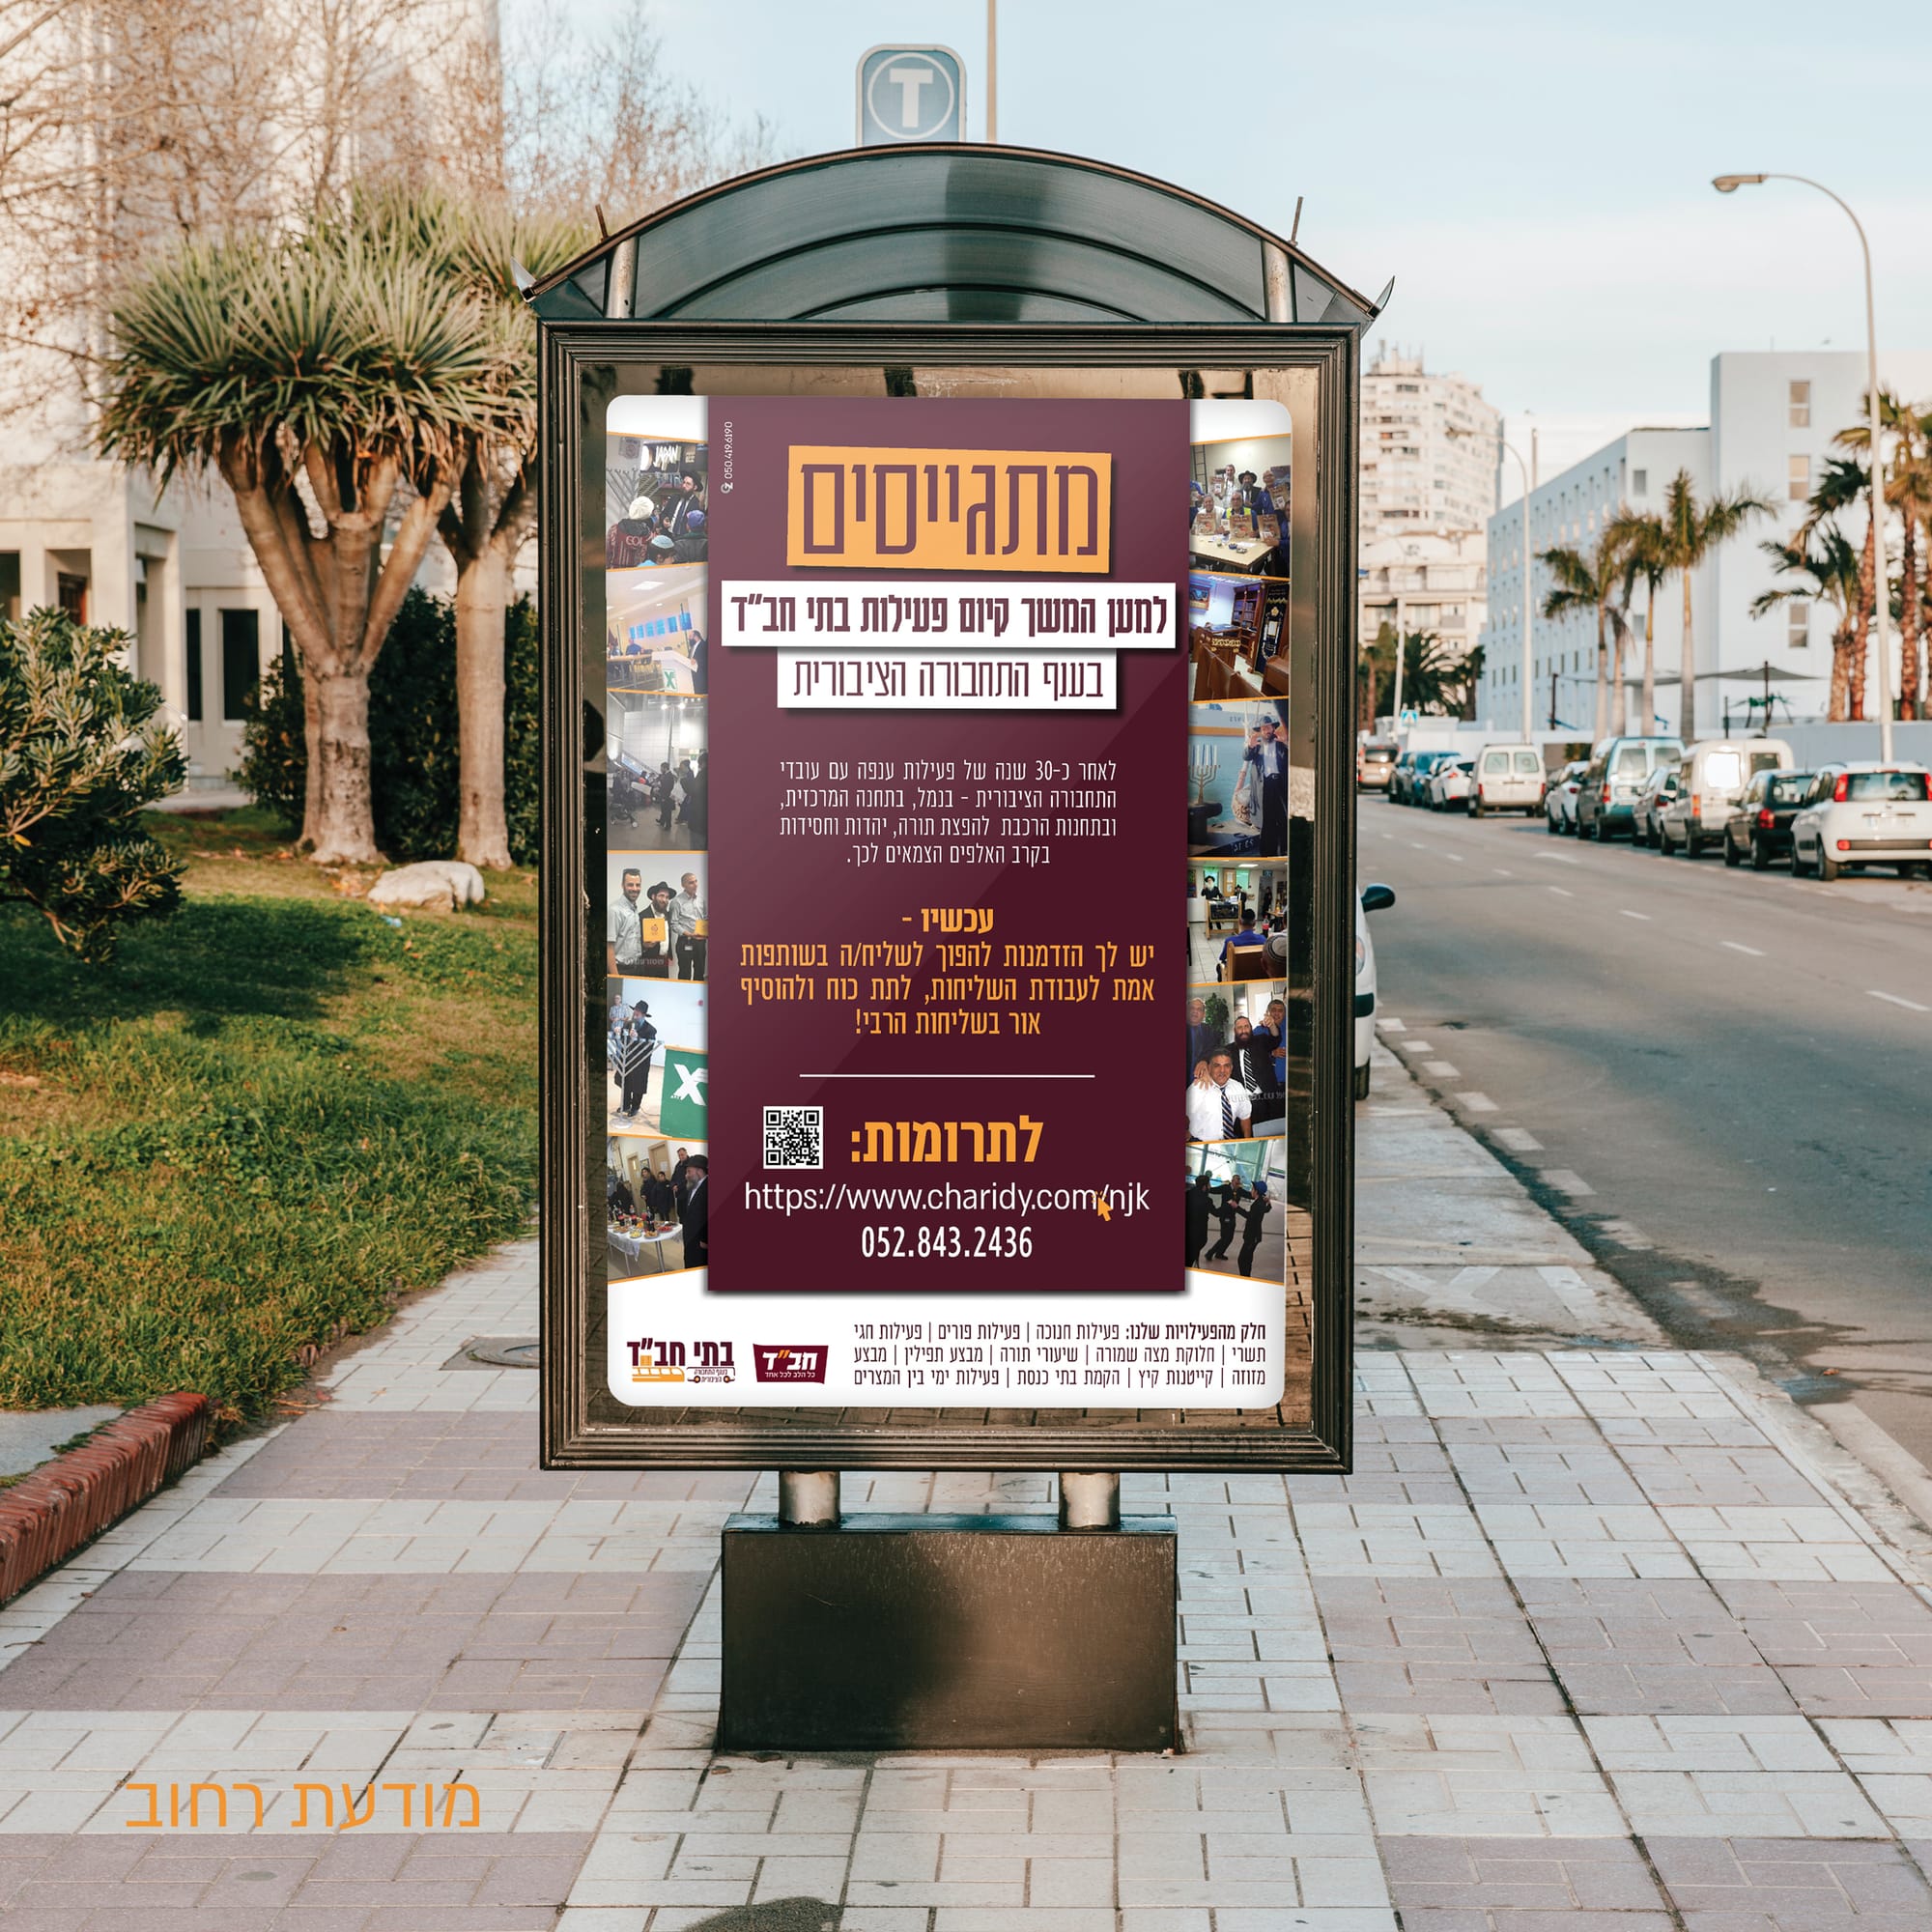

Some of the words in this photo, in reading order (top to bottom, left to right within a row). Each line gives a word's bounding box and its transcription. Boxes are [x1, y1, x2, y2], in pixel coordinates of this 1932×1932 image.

[890, 69, 933, 128] T
[724, 421, 733, 479] 050.419.6190
[801, 465, 1098, 555] מתגייסים
[807, 598, 850, 631] בתי
[861, 595, 947, 632] פעילות
[959, 598, 1009, 637] קיום
[1021, 599, 1095, 637] המשך
[1107, 596, 1166, 637] למען
[794, 661, 905, 696] הציבורית
[920, 662, 1028, 696] התחבורה
[1043, 662, 1103, 700] בענף
[781, 761, 819, 781] עובדי
[830, 761, 847, 781] עם
[858, 761, 894, 781] ענפה
[903, 758, 954, 781] פעילות
[964, 759, 985, 781] של
[996, 762, 1026, 781] שנה
[1079, 759, 1116, 781] לאחר
[781, 788, 848, 810] המרכזית,
[857, 789, 904, 808] בתחנה
[913, 786, 952, 811] בנמל,
[976, 789, 1041, 809] הציבורית
[1051, 790, 1116, 809] התחבורה
[781, 817, 838, 836] וחסידות
[844, 817, 886, 836] יהדות
[894, 817, 934, 839] תורה,
[940, 814, 989, 836] להפצת
[1001, 817, 1049, 837] הרכבת
[1056, 818, 1116, 837] ובתחנות
[847, 841, 878, 867] לכך.
[887, 844, 942, 864] הצמאים
[951, 841, 1004, 864] האלפים
[1012, 845, 1049, 867] בקרב
[922, 909, 994, 934] עכשיו
[741, 944, 828, 967] בשותפות
[841, 941, 923, 970] לשליח/ה
[936, 941, 991, 973] להפוך
[1004, 944, 1082, 967] הזדמנות
[1095, 941, 1119, 973] לך
[1130, 945, 1153, 968] יש
[741, 974, 814, 1006] ולהוסיף
[827, 978, 857, 1001] כוח
[870, 974, 912, 1001] לתת
[924, 974, 1017, 1006] השליחות,
[1030, 974, 1099, 1003] לעבודת
[1113, 978, 1154, 1001] אמת
[856, 1008, 906, 1035] הרבי!
[916, 1008, 1000, 1035] בשליחות
[1009, 1011, 1040, 1035] אור
[851, 1115, 1043, 1163] לתרומות:
[745, 1181, 1150, 1217] https://www.charidy.com/njk
[862, 1226, 1033, 1258] 052.843.2436
[854, 1324, 873, 1341] חגי
[879, 1322, 922, 1340] פעילות
[939, 1324, 971, 1340] פורים
[978, 1322, 1019, 1340] פעילות
[1037, 1324, 1070, 1340] חנוכה
[1076, 1322, 1119, 1340] פעילות
[1126, 1322, 1159, 1340] שלנו:
[1165, 1322, 1235, 1341] מהפעילויות
[1241, 1322, 1265, 1343] חלק
[694, 1342, 734, 1366] בתי
[854, 1348, 886, 1363] מבצע
[905, 1345, 943, 1366] תפילין
[950, 1348, 982, 1363] מבצע
[1001, 1348, 1030, 1363] תורה
[1037, 1348, 1077, 1363] שיעורי
[1096, 1348, 1137, 1363] שמורה
[1145, 1348, 1169, 1363] מצה
[1176, 1345, 1214, 1366] חלוקת
[1233, 1348, 1265, 1363] תשרי
[855, 1370, 899, 1385] המצרים
[908, 1370, 923, 1389] בין
[931, 1370, 949, 1385] ימי
[956, 1368, 999, 1385] פעילות
[1017, 1370, 1048, 1385] כנסת
[1056, 1370, 1076, 1385] בתי
[1084, 1370, 1119, 1389] הקמת
[1139, 1370, 1158, 1389] קיץ
[1166, 1370, 1213, 1388] קייטנות
[1233, 1370, 1265, 1385] מזוזה
